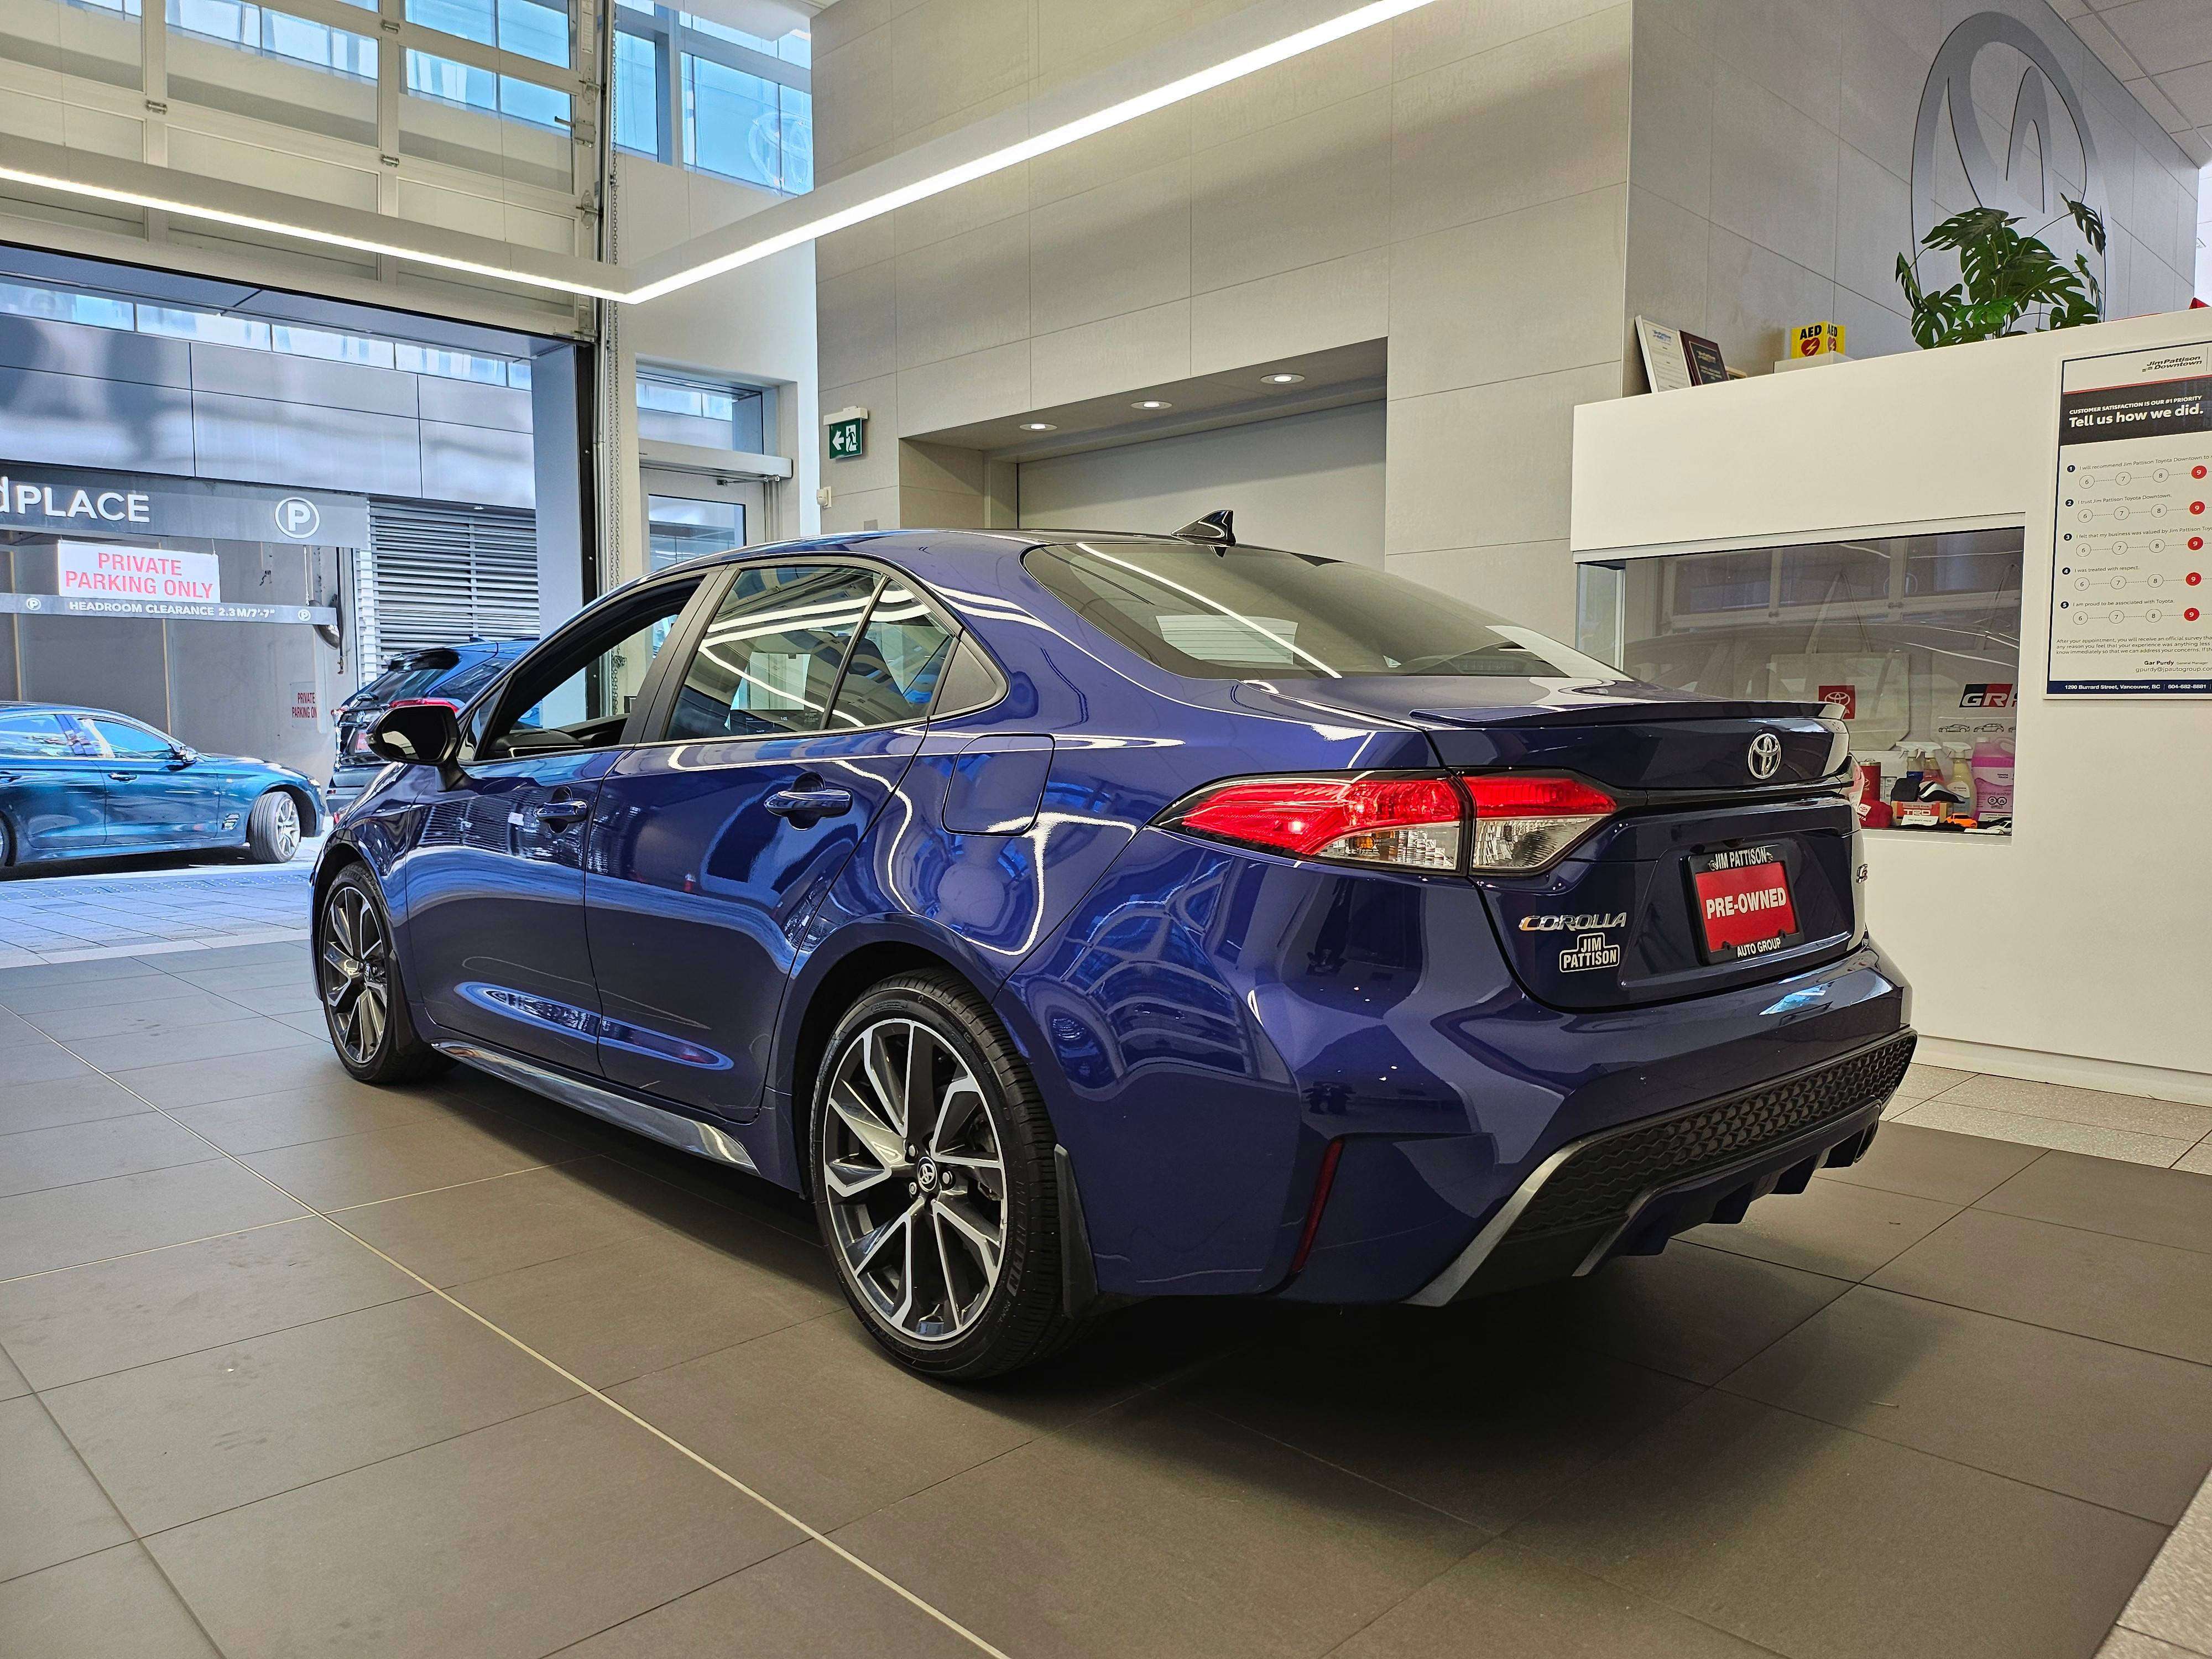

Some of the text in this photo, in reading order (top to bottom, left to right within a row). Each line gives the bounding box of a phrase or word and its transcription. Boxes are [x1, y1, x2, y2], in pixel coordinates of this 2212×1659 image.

[1799, 325, 1822, 340] AED
[1827, 324, 1838, 337] AED
[2154, 360, 2202, 369] Downtown
[2069, 406, 2101, 415] CUSTOMER
[2101, 402, 2143, 411] SATISFACTION
[2069, 403, 2204, 428] Tell us how we did.
[16, 485, 150, 523] PLACE
[288, 503, 311, 531] P
[98, 552, 182, 576] PRIVATE
[65, 570, 213, 599] PARKING ONLY
[69, 601, 143, 613] HEADROOM
[145, 603, 215, 616] CLEARANCE
[297, 692, 316, 704] PRIVATE
[1961, 693, 2008, 707] GR
[291, 707, 310, 718] PARKING
[1714, 847, 1767, 870] JIM PATTISON
[1705, 887, 1786, 920] PRE-OWNED
[1519, 912, 1627, 931] COROLLA
[1580, 937, 1601, 952] JIM
[1736, 937, 1781, 958] AUTO GROUP
[1563, 949, 1617, 969] PATTISON
